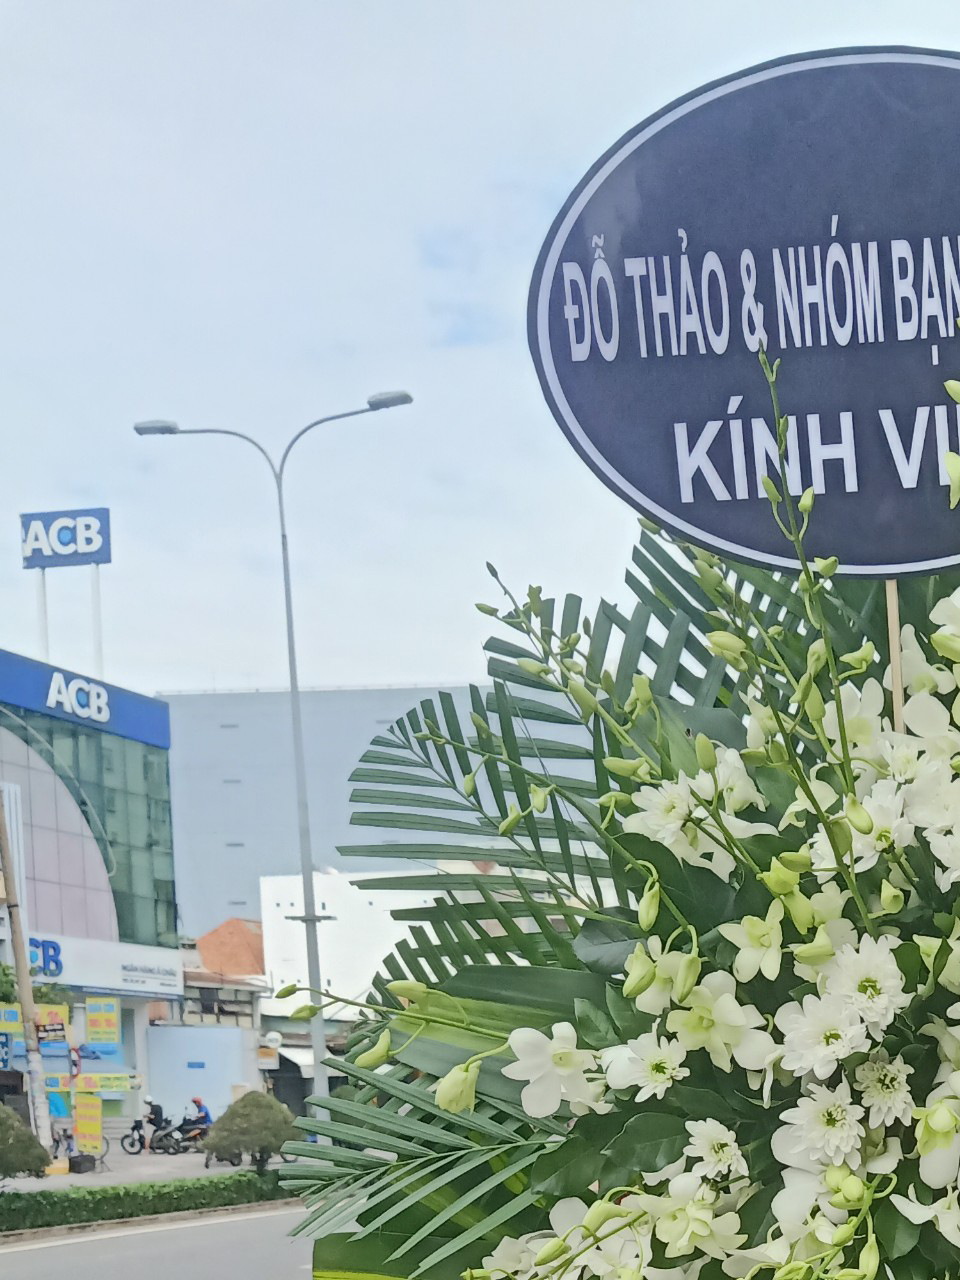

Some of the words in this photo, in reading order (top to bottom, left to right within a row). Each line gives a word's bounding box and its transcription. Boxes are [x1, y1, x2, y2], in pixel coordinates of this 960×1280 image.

[562, 234, 620, 362] ĐỖ
[624, 228, 731, 358] THẢO
[740, 248, 768, 352] &
[772, 214, 885, 350] NHÓM
[673, 395, 858, 503] KÍNH
[24, 516, 103, 557] ACB
[46, 671, 111, 723] ACB
